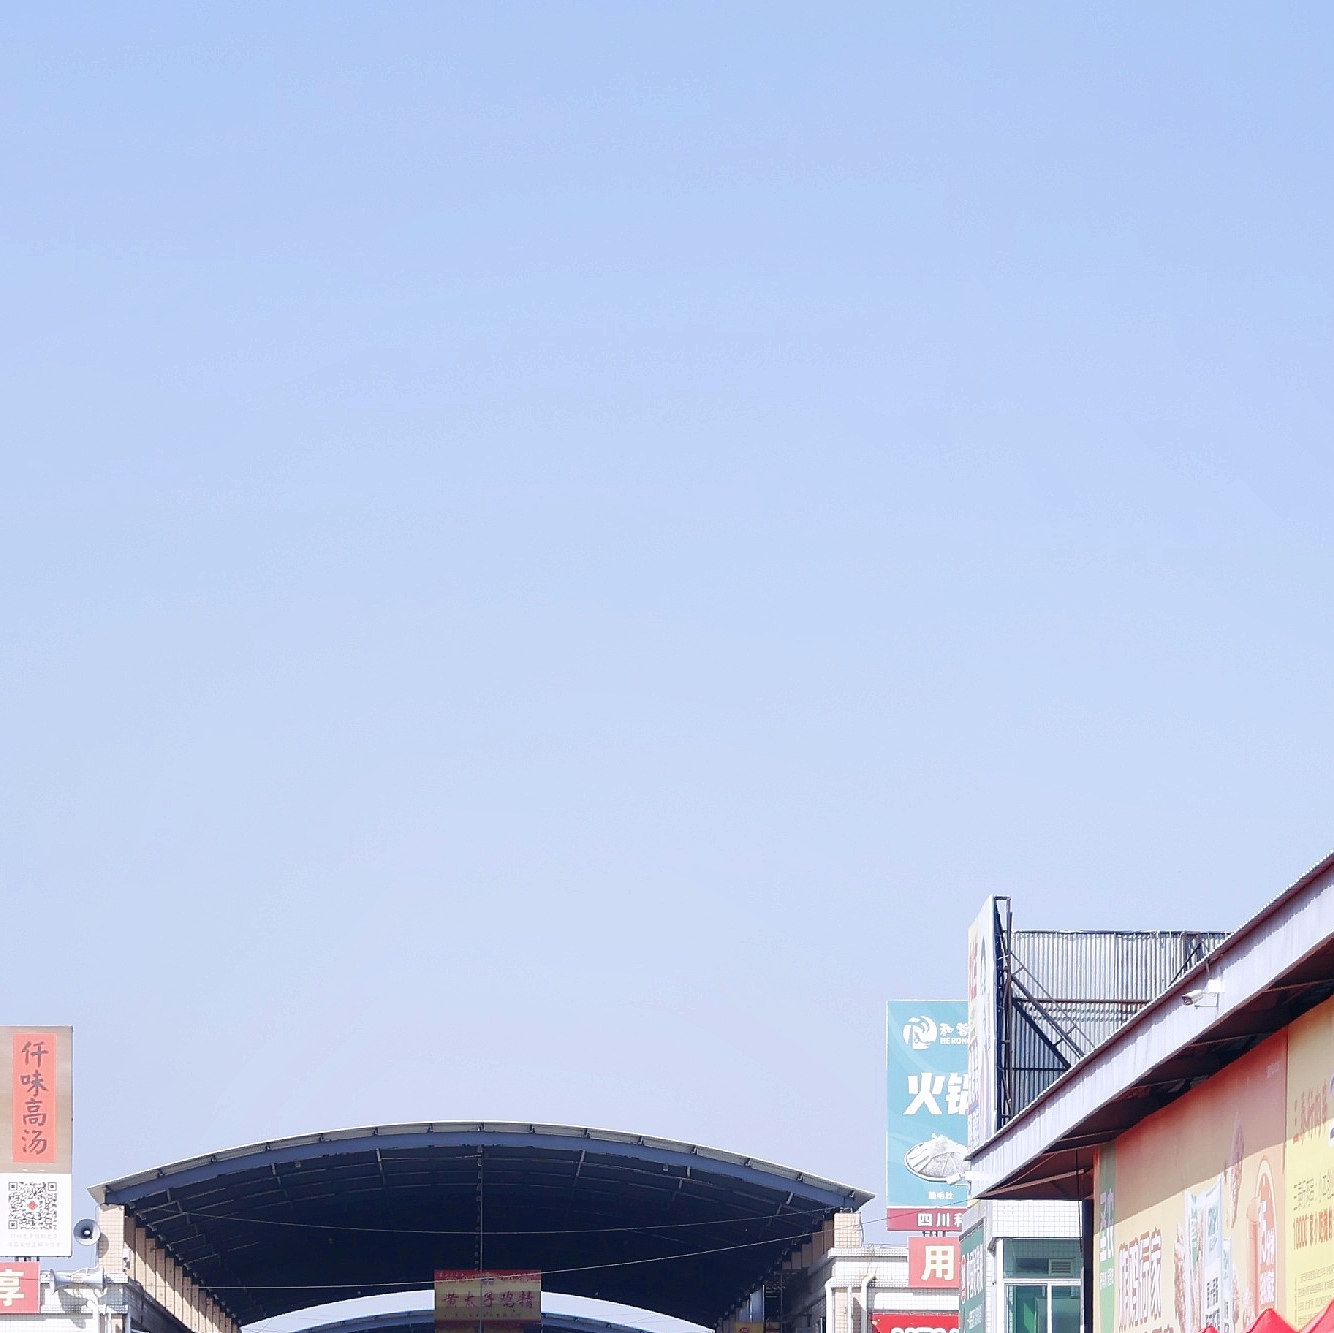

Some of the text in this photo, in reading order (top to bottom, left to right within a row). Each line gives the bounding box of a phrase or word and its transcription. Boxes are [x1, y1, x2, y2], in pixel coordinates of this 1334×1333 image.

[20, 1040, 50, 1155] 仟味高汤
[920, 1245, 955, 1282] 用
